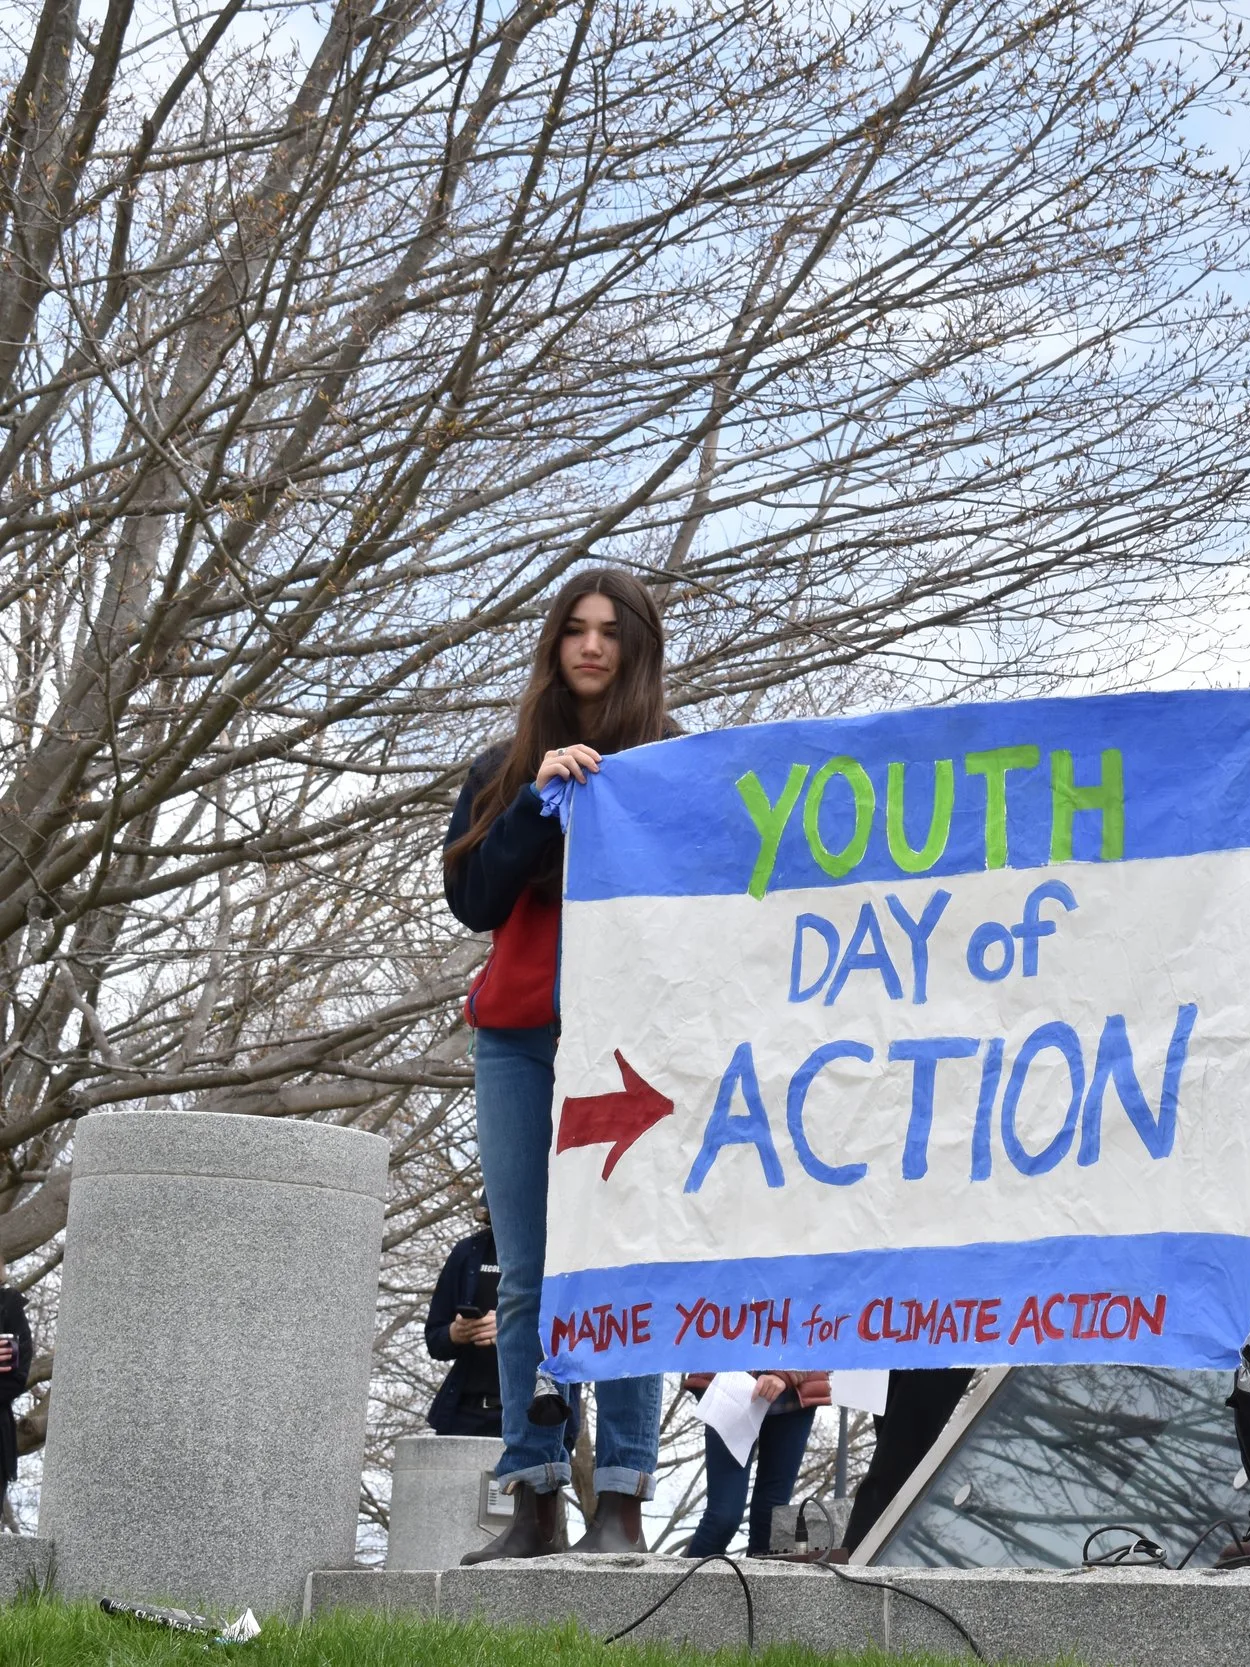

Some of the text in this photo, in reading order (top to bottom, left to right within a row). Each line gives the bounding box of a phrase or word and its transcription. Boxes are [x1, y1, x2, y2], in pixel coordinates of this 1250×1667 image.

[735, 744, 1125, 900] YOUTH
[789, 880, 1078, 1005] DAY of
[684, 1003, 1197, 1194] ACTION
[550, 1292, 1168, 1357] MAINE YOUTH for CLIMATE ACTION
